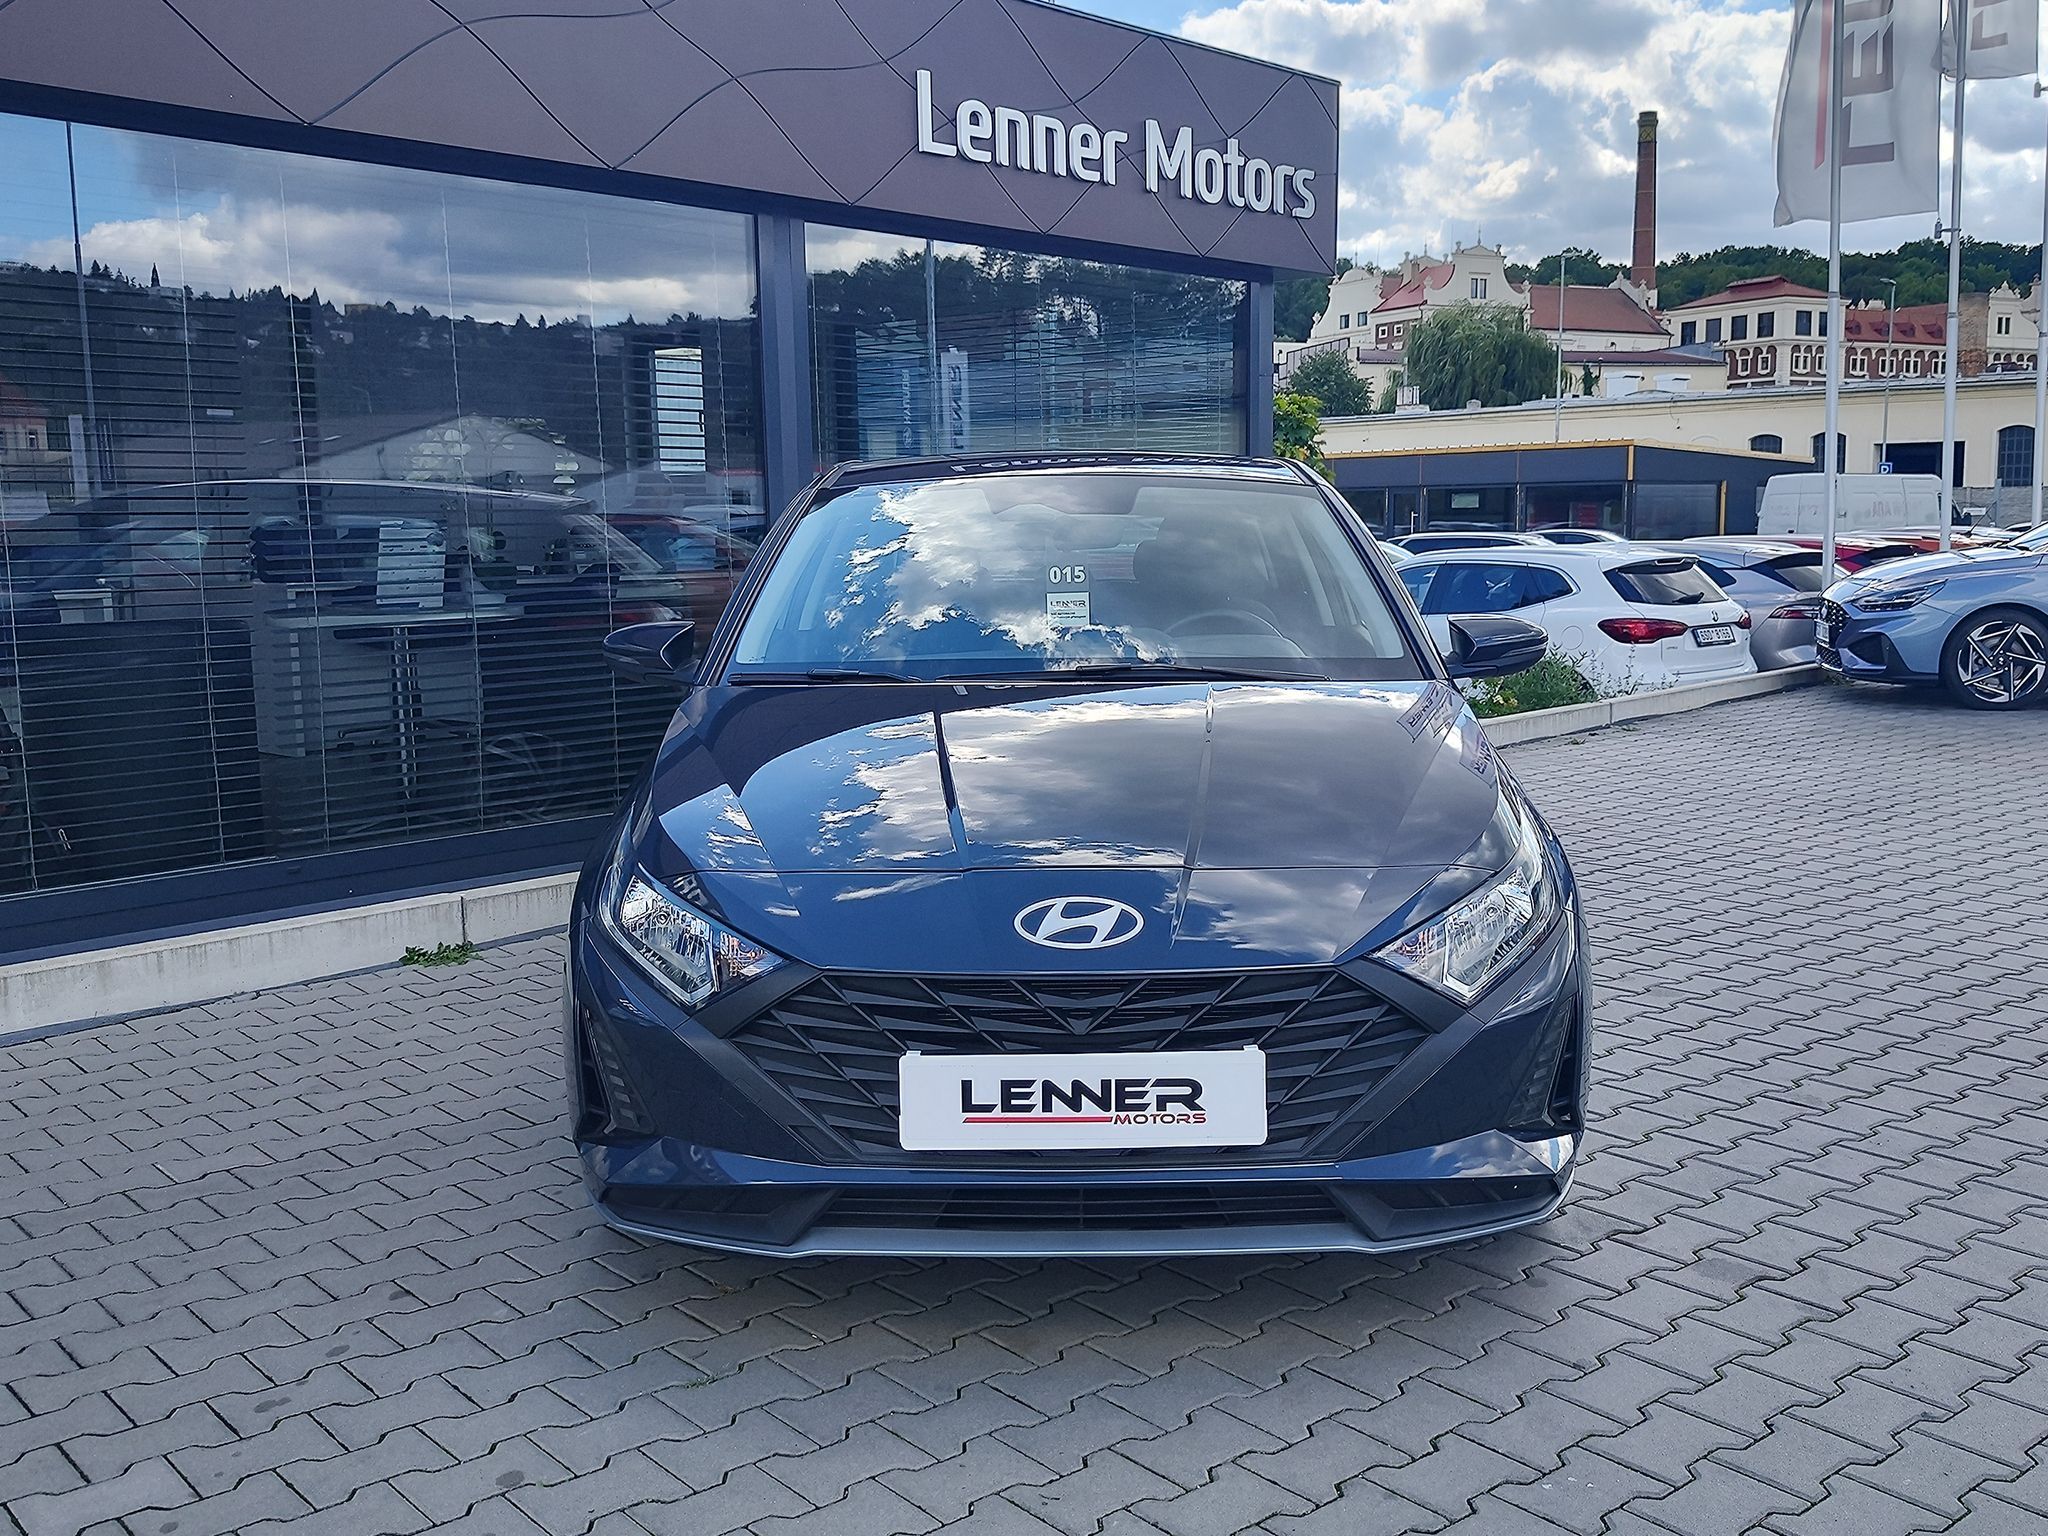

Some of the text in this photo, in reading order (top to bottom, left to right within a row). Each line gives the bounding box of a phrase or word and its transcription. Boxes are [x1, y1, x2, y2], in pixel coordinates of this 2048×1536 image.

[1841, 0, 1895, 167] LE
[915, 68, 1316, 218] Lenner Motors
[1049, 565, 1087, 584] 015
[961, 1078, 1207, 1114] LENNER
[1113, 1112, 1207, 1125] MOTORS
